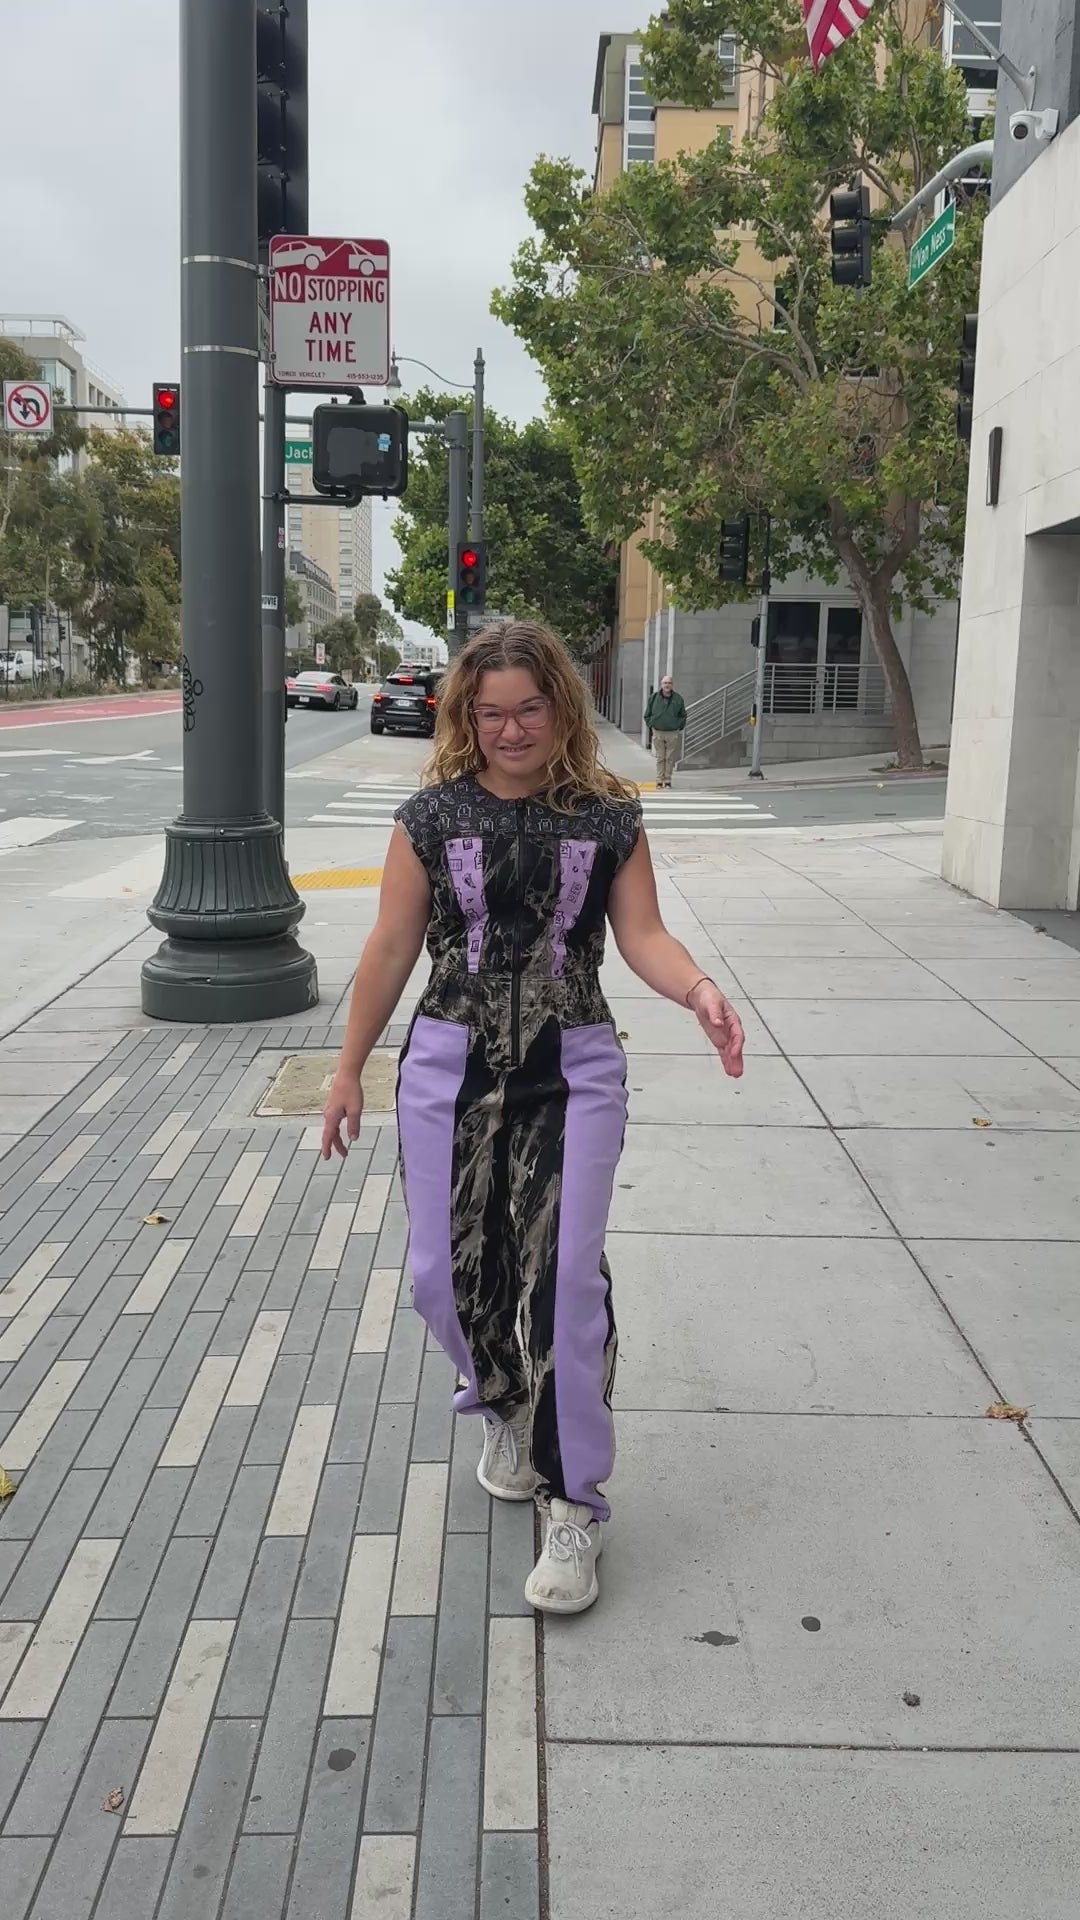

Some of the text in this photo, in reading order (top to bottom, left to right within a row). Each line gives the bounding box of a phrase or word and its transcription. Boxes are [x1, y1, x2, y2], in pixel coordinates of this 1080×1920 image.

[916, 244, 929, 269] Van
[930, 226, 946, 256] Ness
[274, 271, 385, 303] NO STOPPING
[309, 311, 352, 334] ANY
[305, 339, 357, 363] TIME
